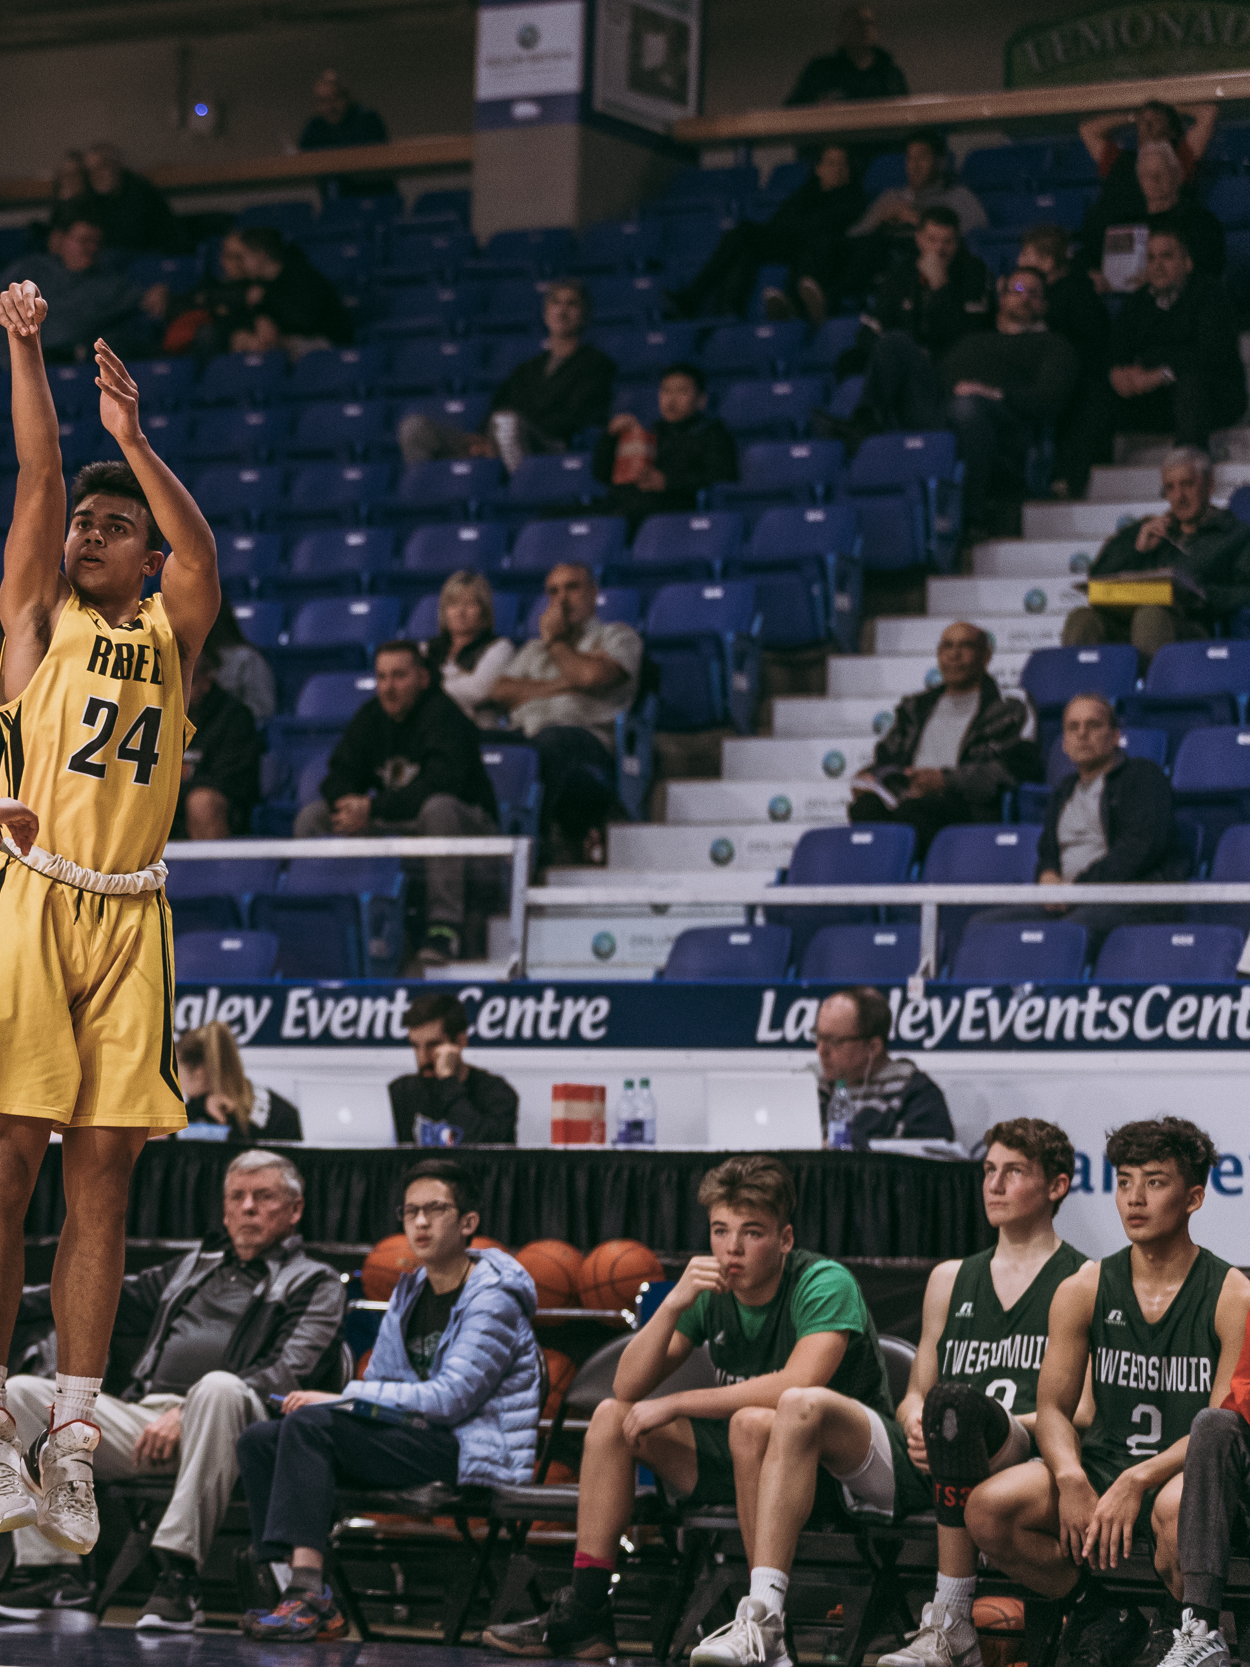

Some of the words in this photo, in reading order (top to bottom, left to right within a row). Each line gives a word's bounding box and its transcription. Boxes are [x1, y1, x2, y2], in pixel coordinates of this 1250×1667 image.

[66, 694, 163, 787] 24
[281, 986, 411, 1040] Event
[1126, 1402, 1162, 1456] 2
